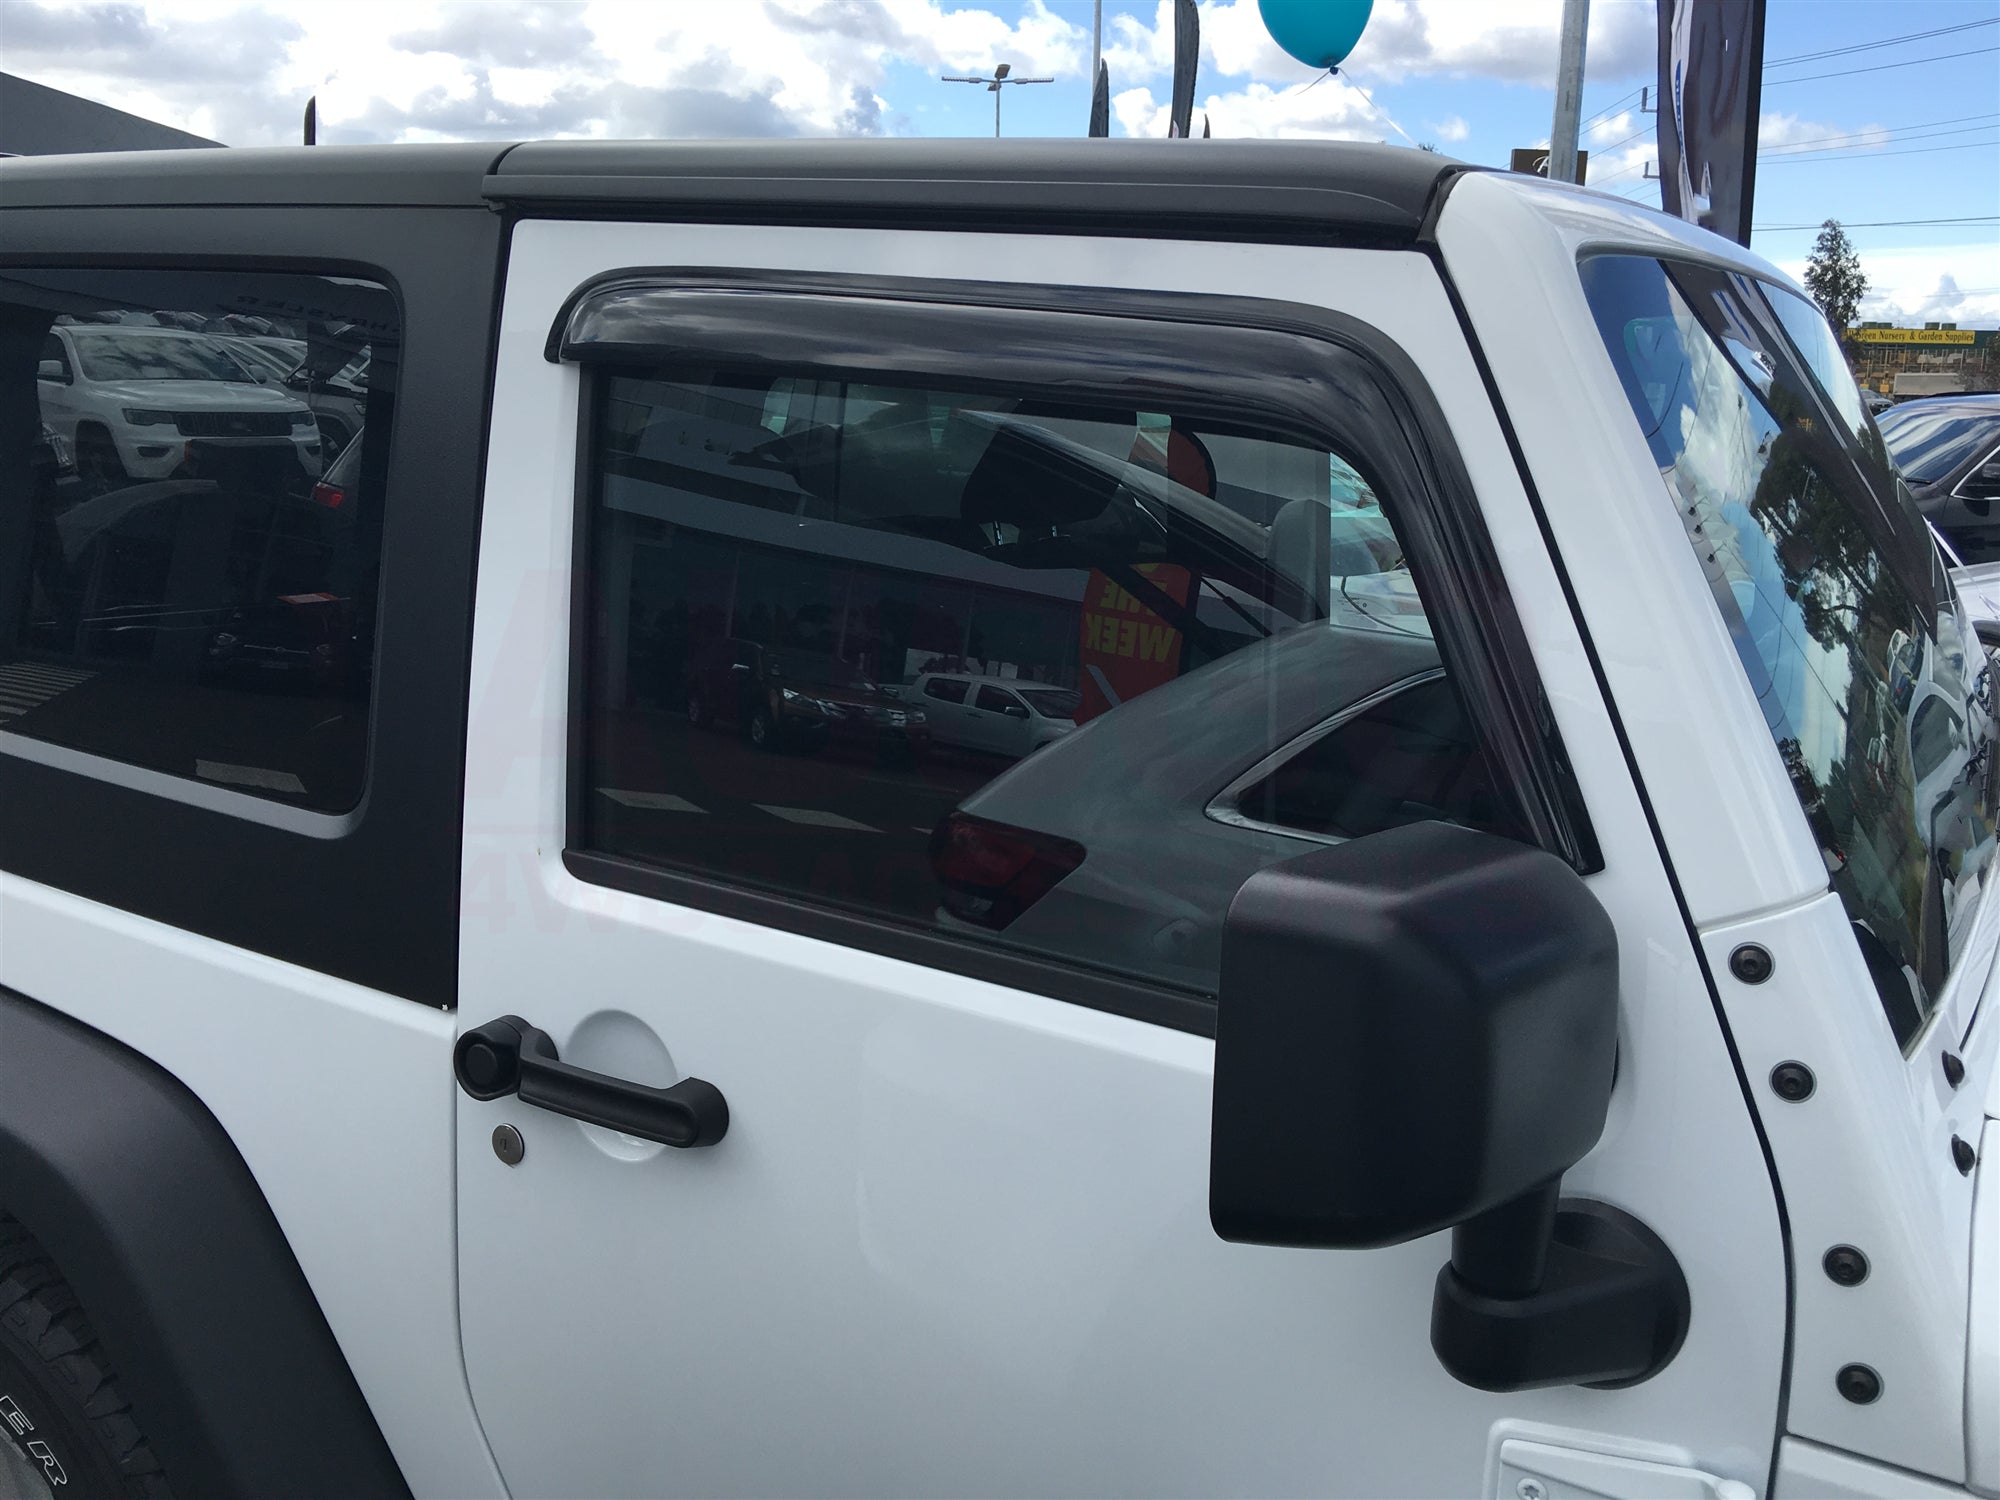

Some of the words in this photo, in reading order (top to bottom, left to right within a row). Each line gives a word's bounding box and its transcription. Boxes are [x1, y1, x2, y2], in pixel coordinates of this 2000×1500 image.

[1879, 331, 1905, 341] Nursery
[1909, 331, 1915, 340] &
[1918, 331, 1943, 341] Garden
[1945, 332, 1974, 343] Supplies
